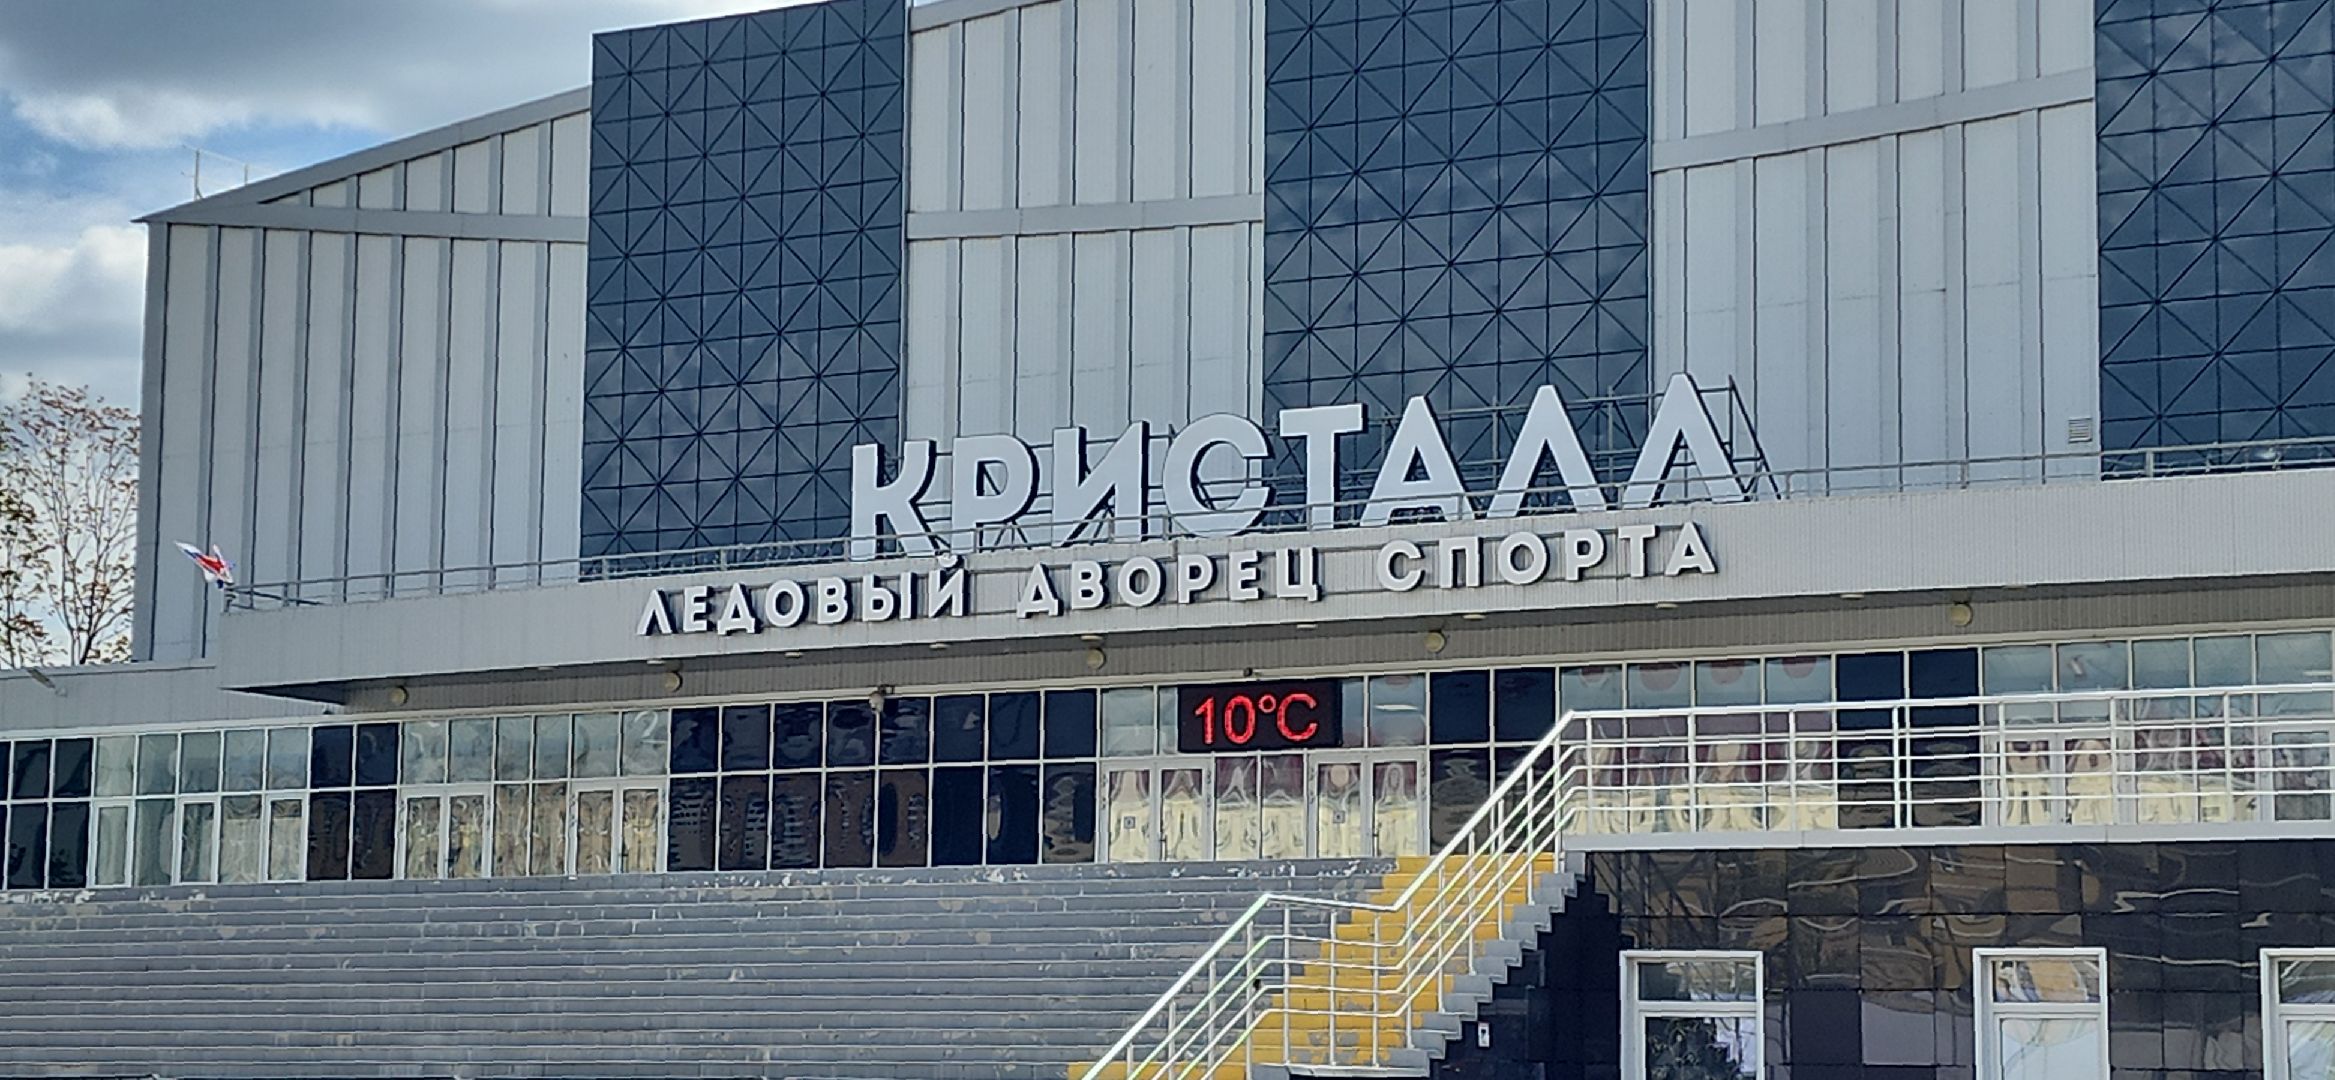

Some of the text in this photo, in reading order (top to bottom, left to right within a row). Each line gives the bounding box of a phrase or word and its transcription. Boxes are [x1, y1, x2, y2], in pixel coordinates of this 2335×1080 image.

[851, 372, 1750, 561] КРИСТАЛЛ
[637, 521, 1717, 635] ЛЕДОВЫЙ ДВОРЕЦ СПОРТА
[1195, 692, 1319, 745] 10°C
